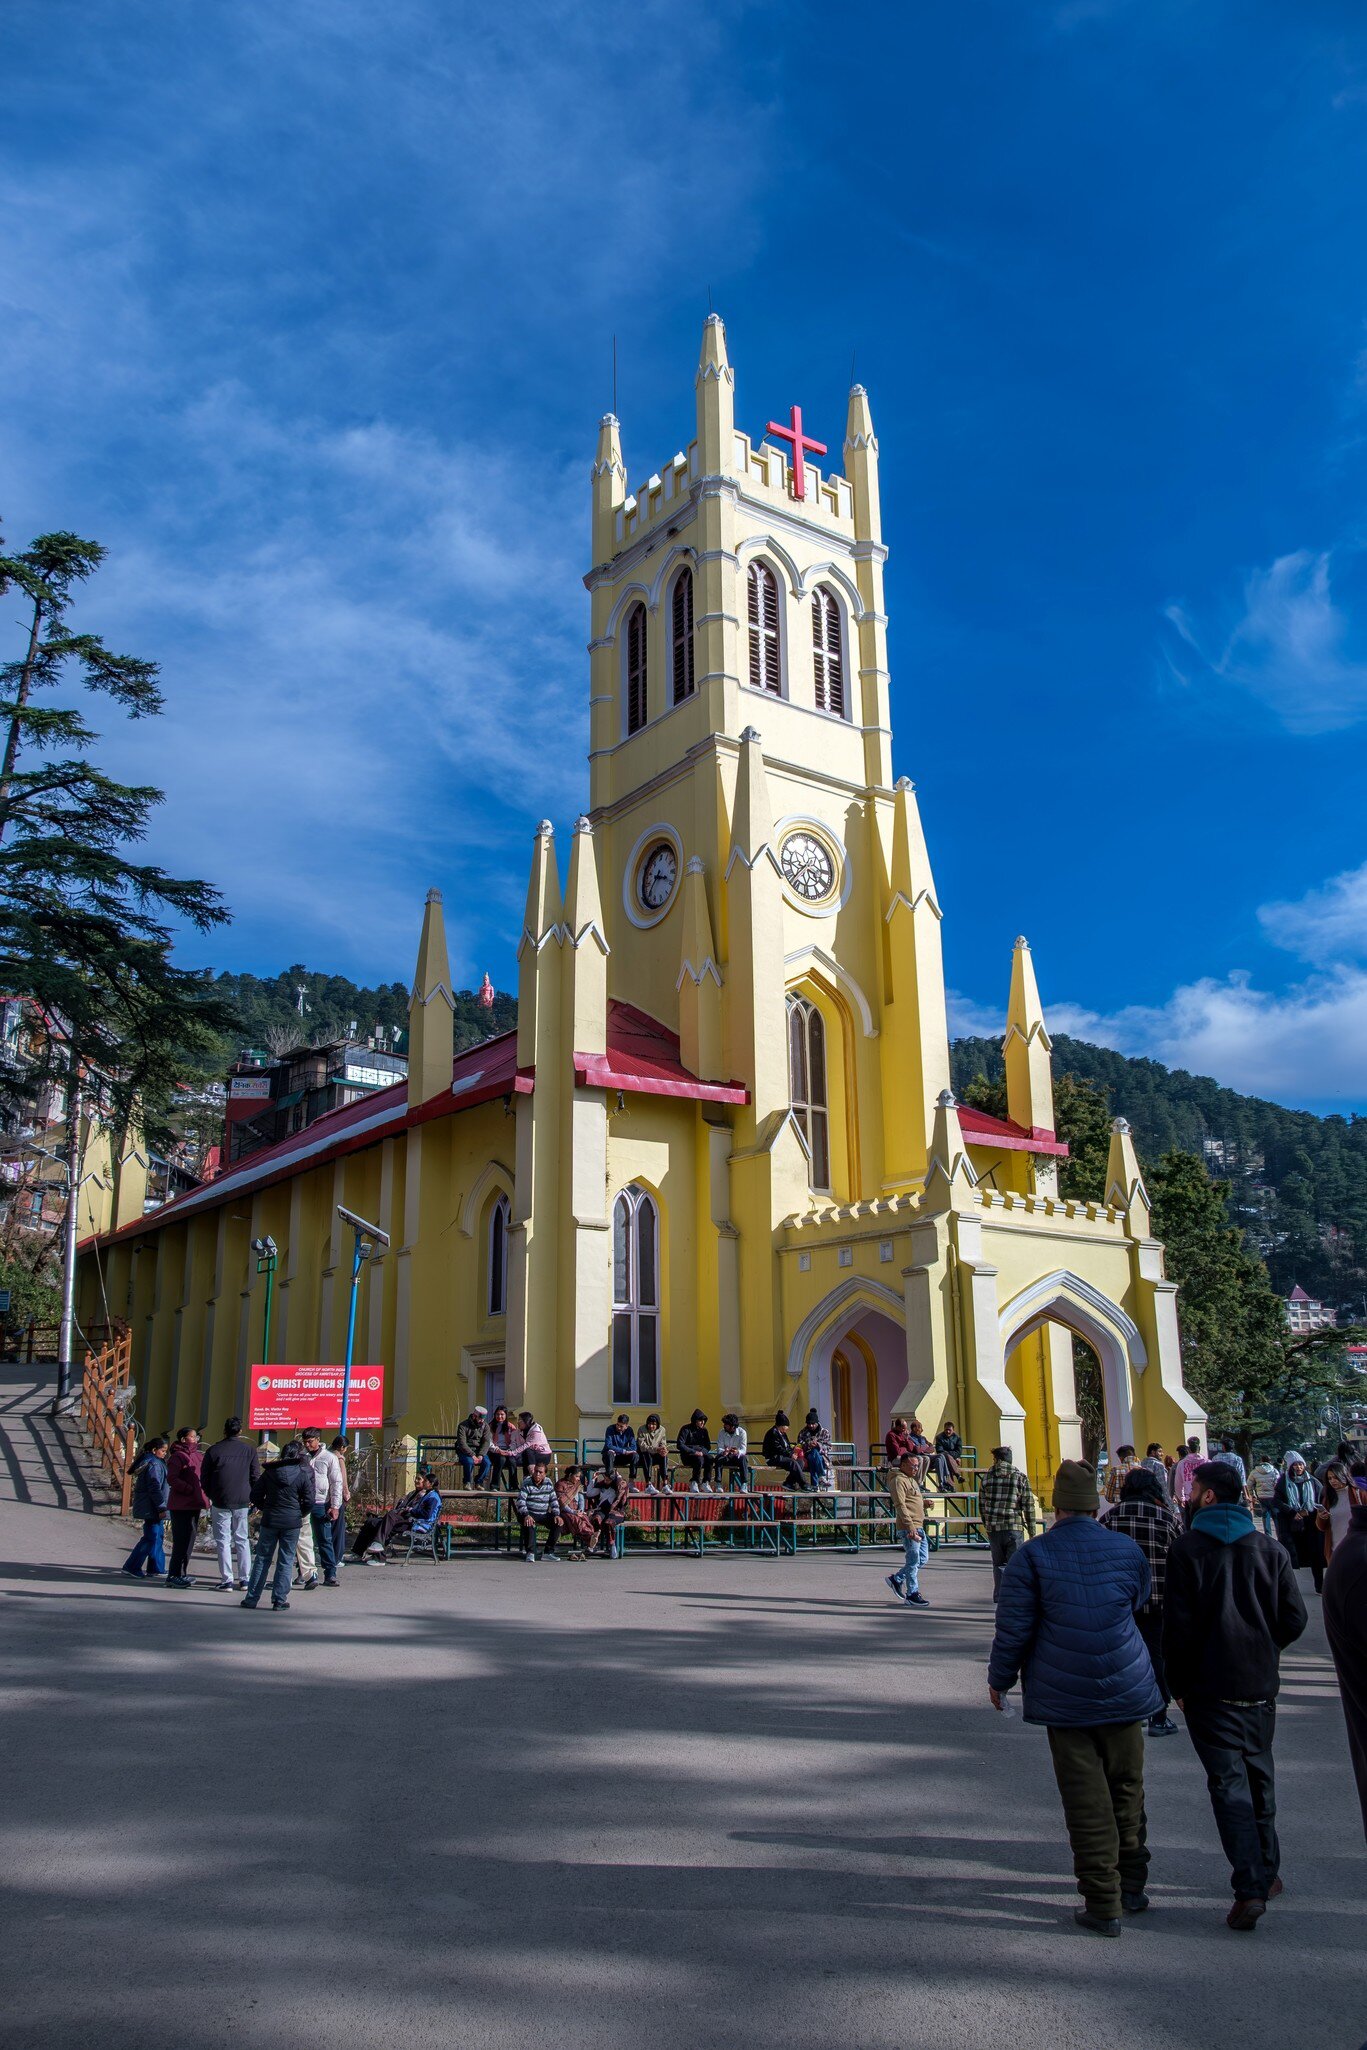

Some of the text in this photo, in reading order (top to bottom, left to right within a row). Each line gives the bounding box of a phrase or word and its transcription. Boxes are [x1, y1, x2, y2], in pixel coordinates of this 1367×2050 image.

[272, 1379, 366, 1388] CHRIST CHURCH SMLA
